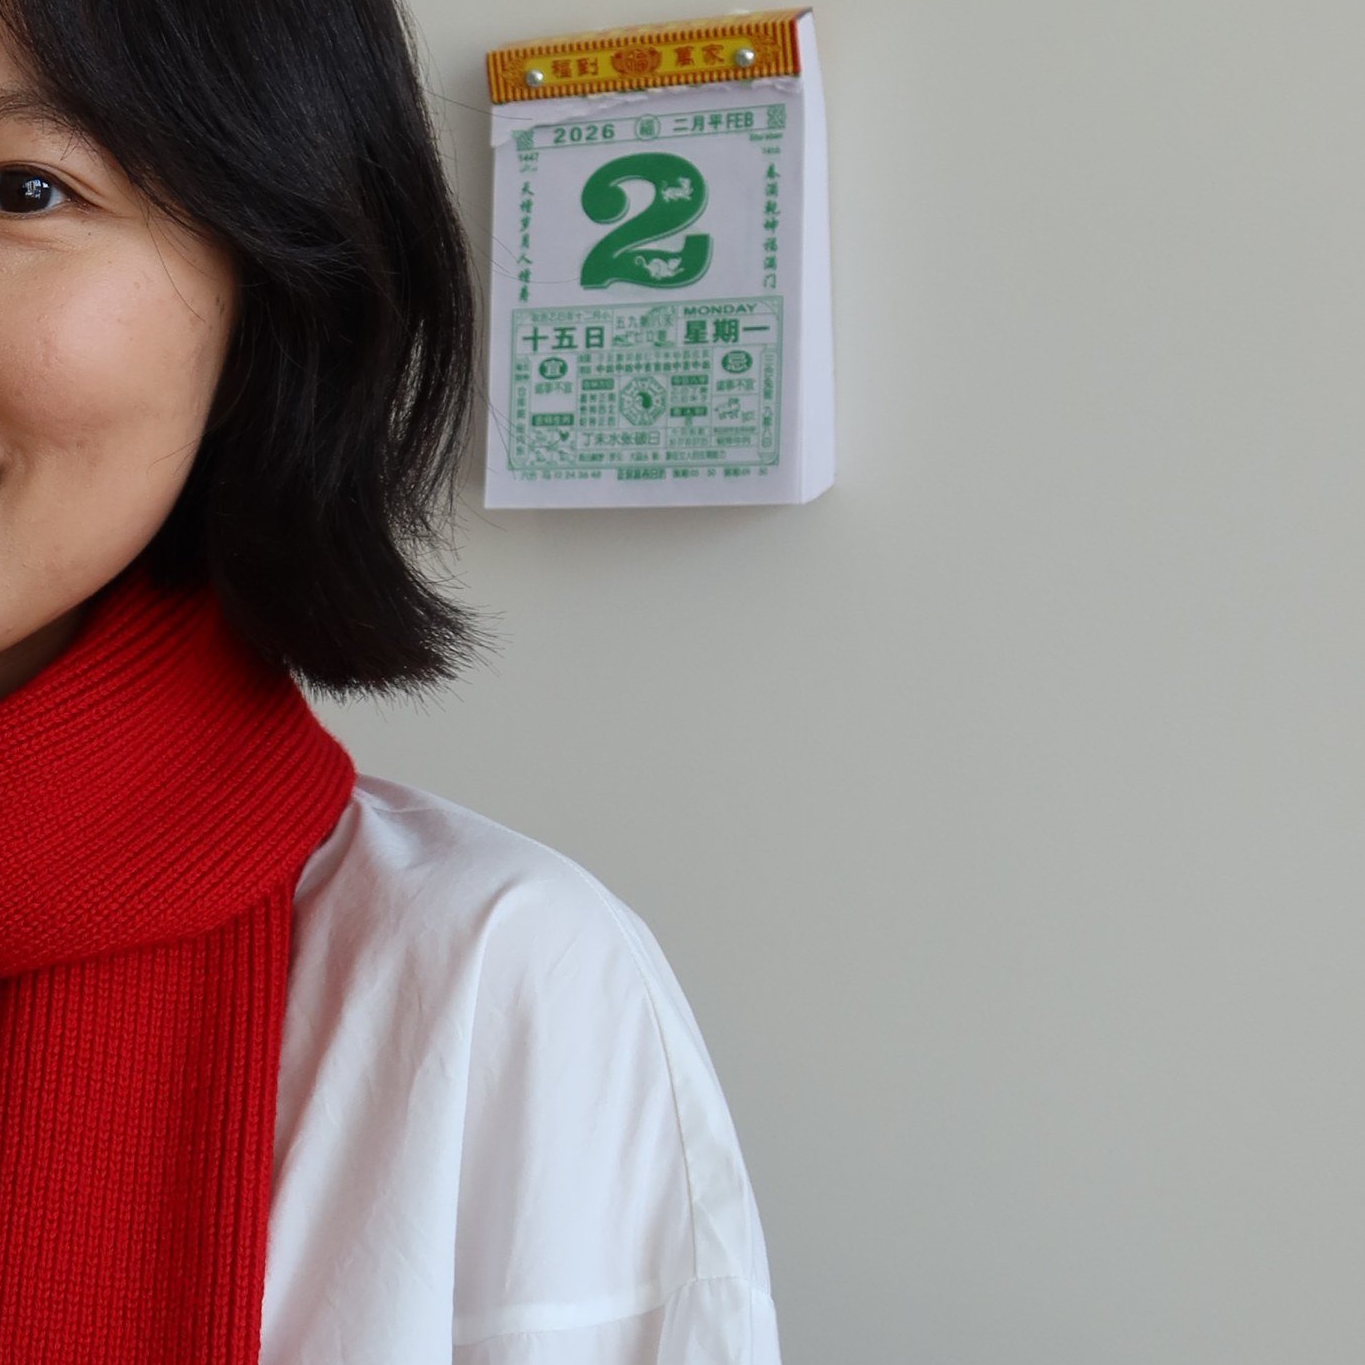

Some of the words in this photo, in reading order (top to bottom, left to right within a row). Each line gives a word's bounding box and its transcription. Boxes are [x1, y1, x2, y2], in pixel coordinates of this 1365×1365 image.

[553, 123, 615, 143] 2026
[580, 151, 713, 291] 2
[683, 304, 757, 315] MONDAY
[521, 326, 605, 352] 十五日
[682, 318, 771, 345] 星期一
